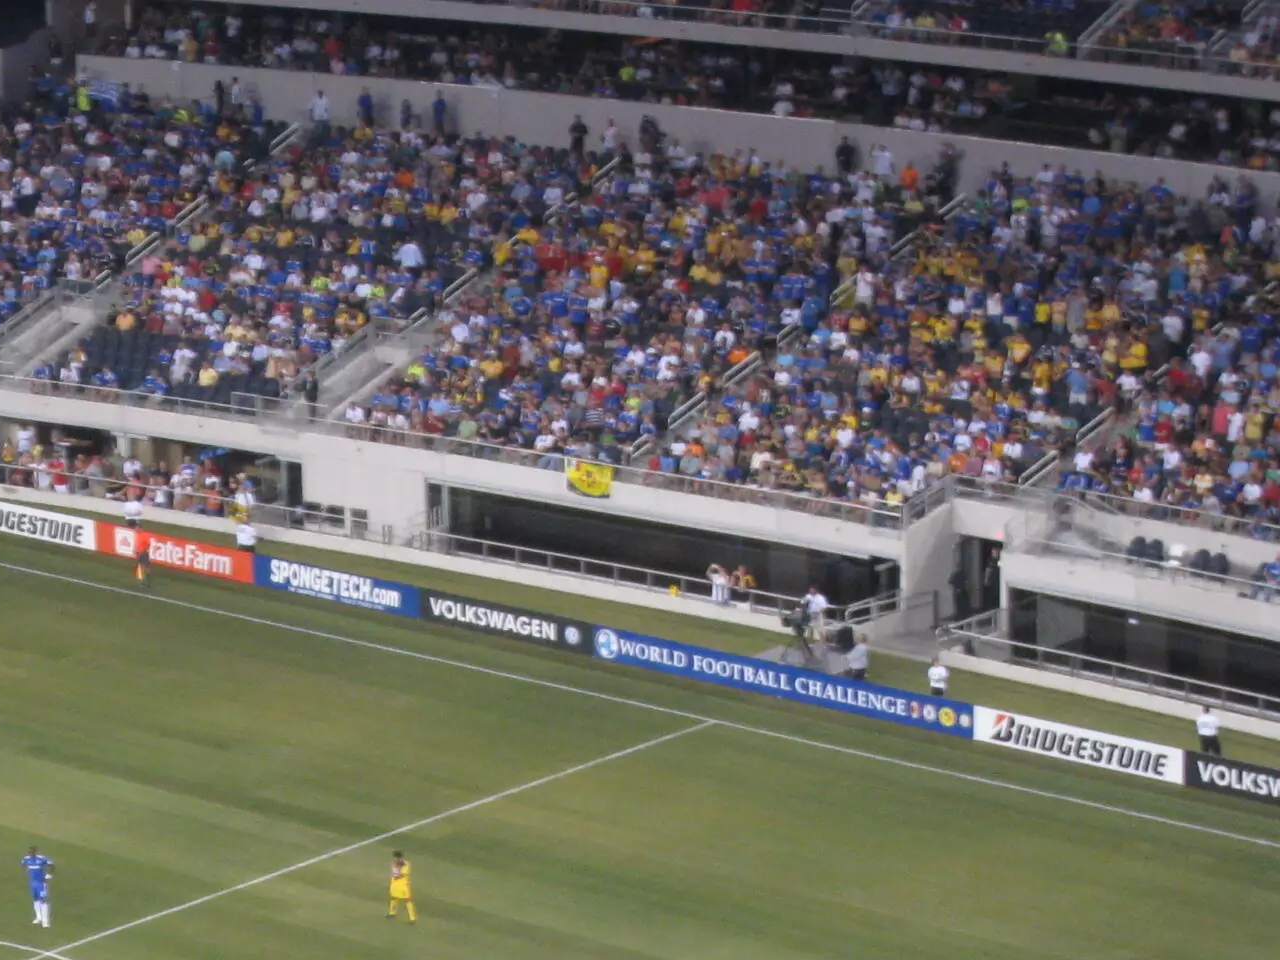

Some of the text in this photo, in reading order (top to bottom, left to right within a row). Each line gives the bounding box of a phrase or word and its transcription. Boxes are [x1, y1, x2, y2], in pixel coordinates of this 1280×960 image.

[269, 558, 401, 607] SPONGETECH.com
[429, 597, 557, 641] VOLKSWAGEN
[619, 638, 907, 716] WORLD FOOTBALL CHALLENGE
[991, 714, 1169, 777] BRIDGESTONE
